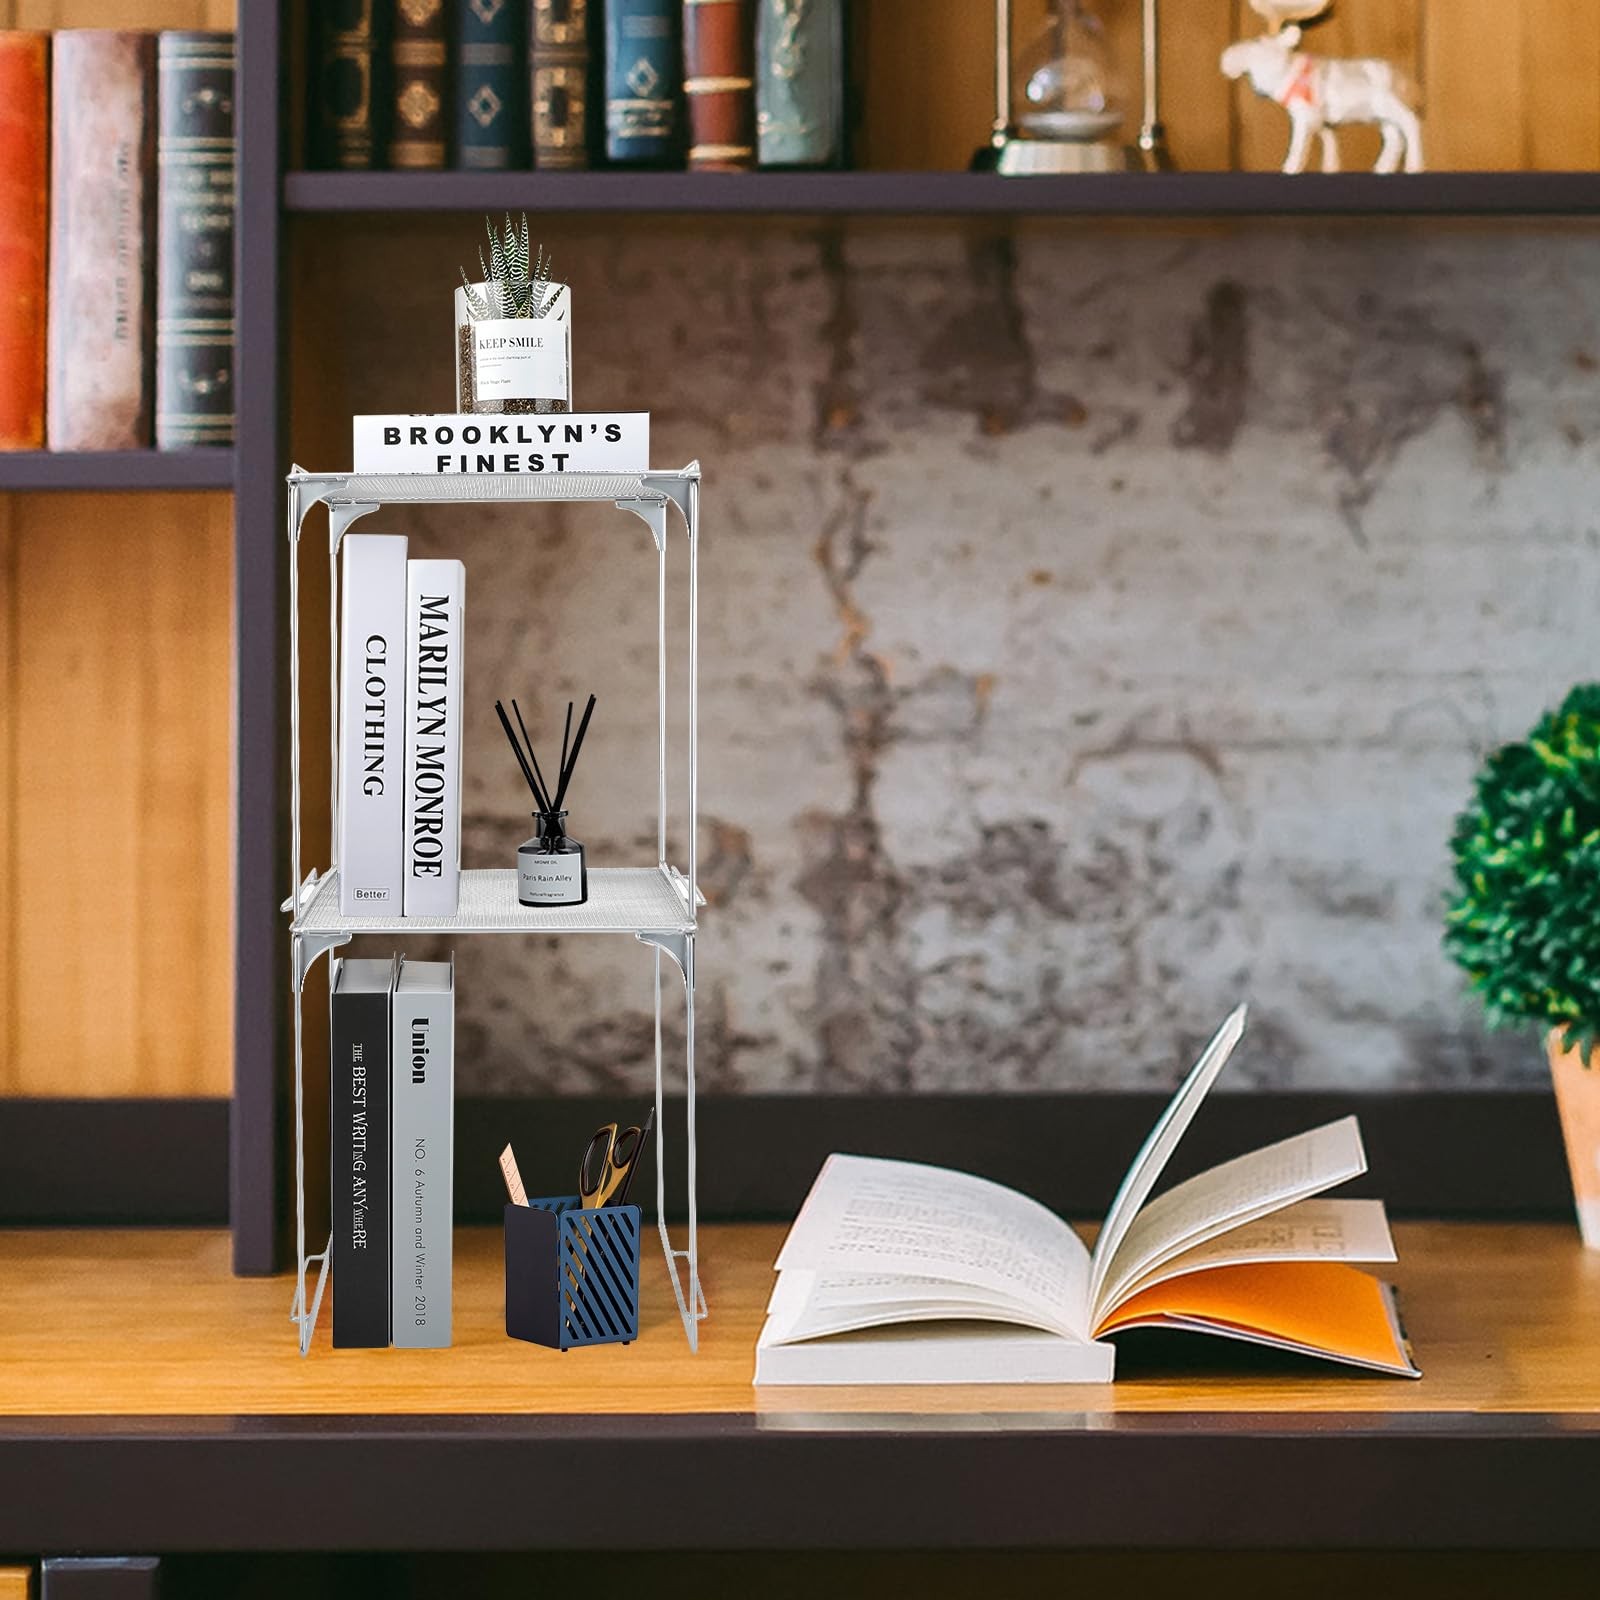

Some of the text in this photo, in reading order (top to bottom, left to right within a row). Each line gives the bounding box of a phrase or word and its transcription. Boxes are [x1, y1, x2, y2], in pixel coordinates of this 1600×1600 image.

[480, 336, 543, 349] KEEP SMILE
[437, 453, 570, 473] FINEST
[363, 634, 387, 798] CLOTHING
[412, 594, 450, 878] MARILYN MONROE
[522, 872, 536, 881] Paris
[537, 873, 554, 882] Rain
[356, 890, 386, 899] Better
[352, 1043, 363, 1062] THE
[411, 1018, 430, 1084] Union
[352, 1066, 367, 1108] BEST
[414, 1138, 426, 1326] NO. 6 Autumn and Winter 2018
